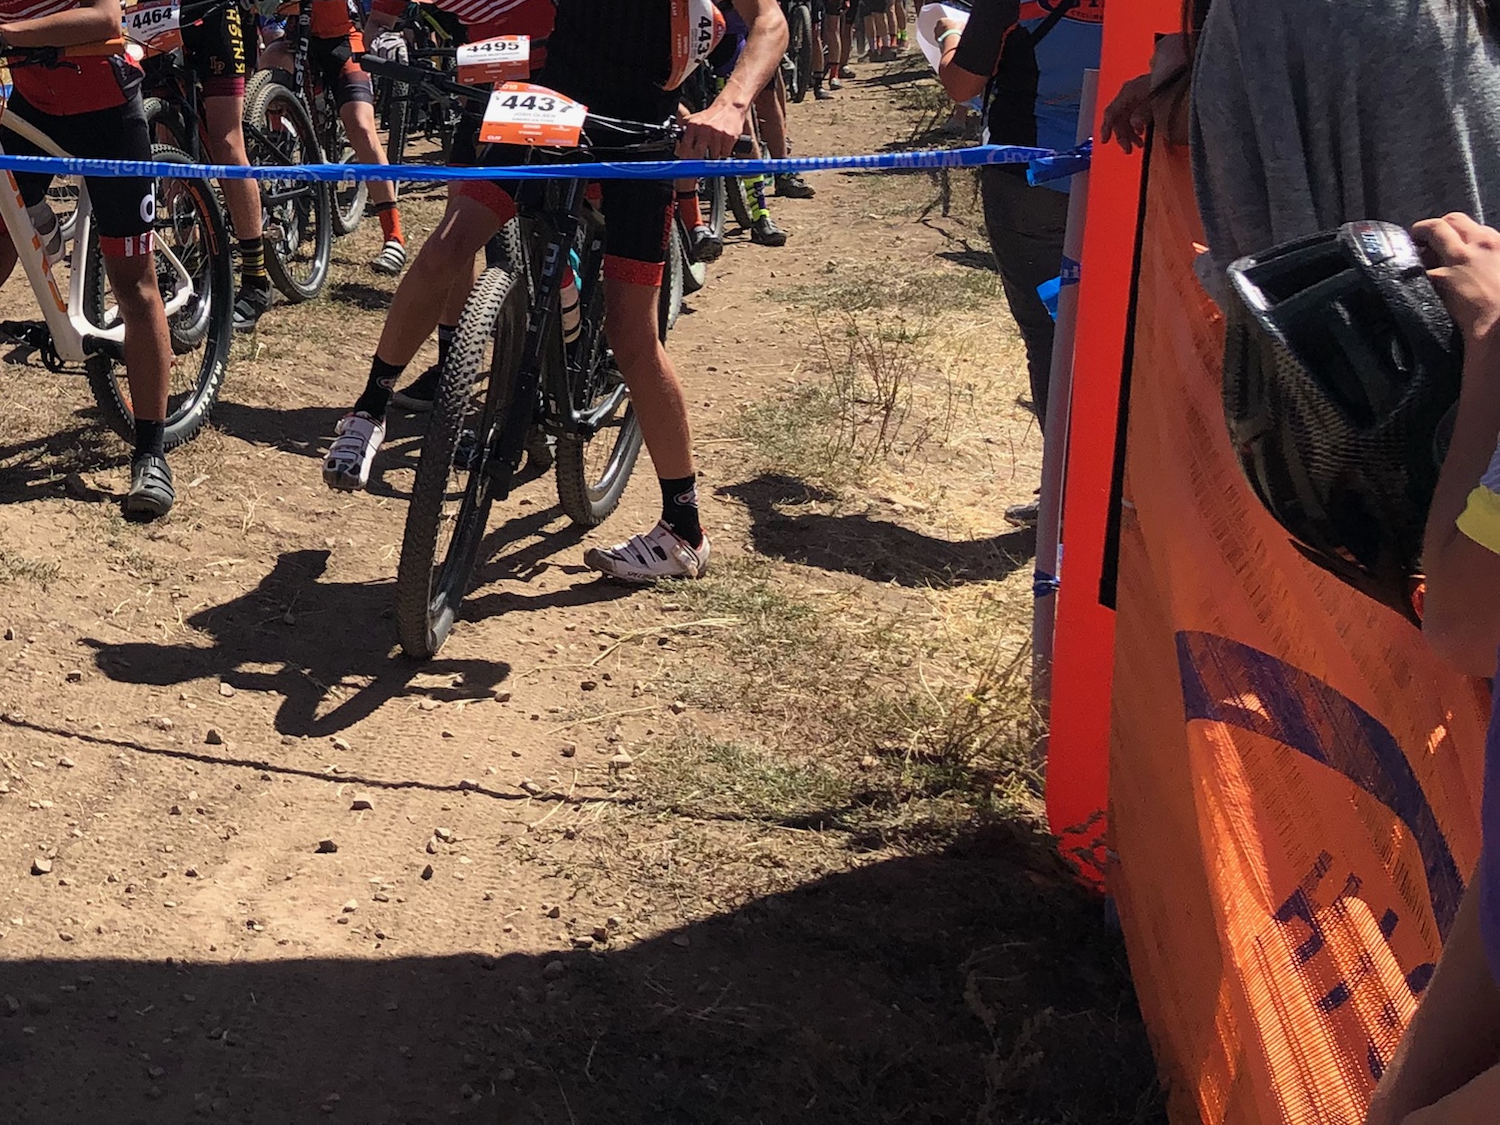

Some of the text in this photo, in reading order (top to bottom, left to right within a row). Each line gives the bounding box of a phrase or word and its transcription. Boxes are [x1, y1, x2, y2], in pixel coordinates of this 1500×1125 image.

[133, 8, 172, 28] 4464
[467, 42, 519, 52] 4495
[694, 16, 712, 63] 443
[501, 95, 574, 113] 4437
